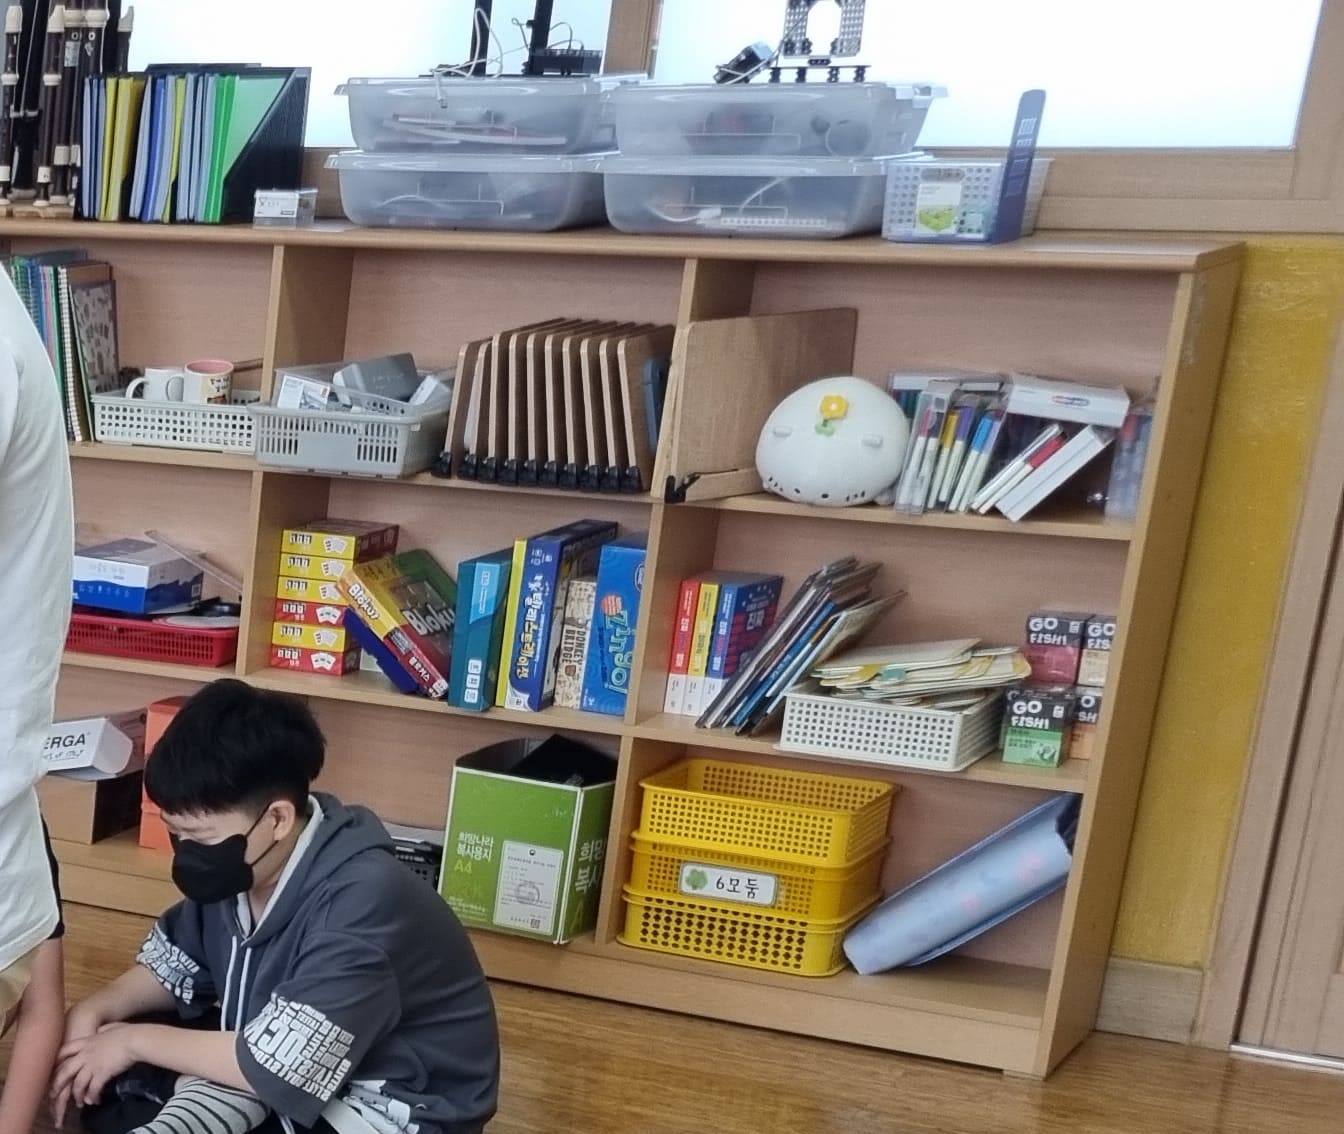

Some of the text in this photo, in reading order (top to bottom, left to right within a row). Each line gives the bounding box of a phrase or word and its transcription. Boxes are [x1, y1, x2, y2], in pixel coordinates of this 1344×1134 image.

[348, 582, 381, 620] Blokus
[402, 602, 456, 636] Bloku
[1029, 617, 1059, 631] GO
[562, 628, 576, 664] BRIDGE
[573, 628, 587, 665] DONKEY
[1087, 638, 1111, 650] FIS
[1013, 700, 1043, 715] GO
[454, 861, 473, 875] A4
[715, 875, 759, 899] 6모둠
